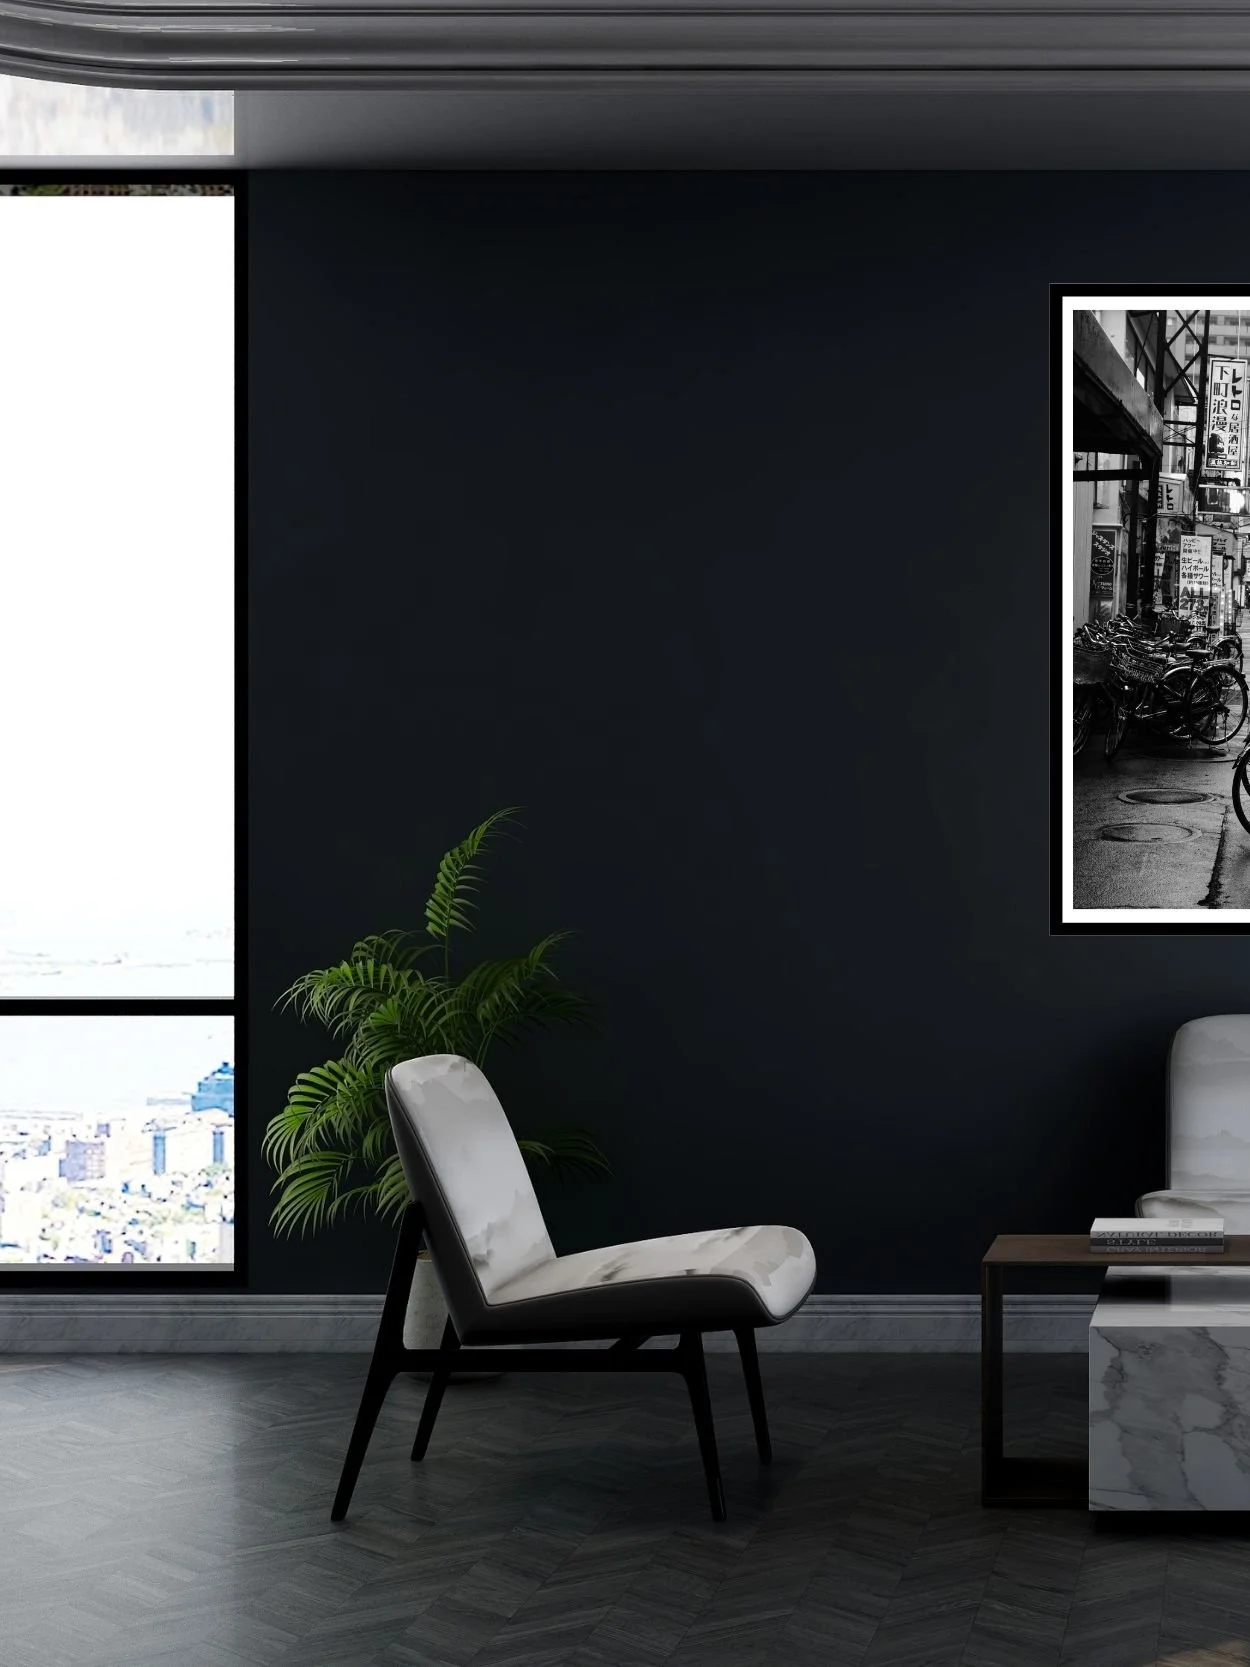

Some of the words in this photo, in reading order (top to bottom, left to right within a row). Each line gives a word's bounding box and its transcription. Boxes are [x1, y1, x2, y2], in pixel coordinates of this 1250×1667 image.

[1211, 365, 1230, 432] 下町浪漫
[1166, 484, 1174, 511] レトロ
[1181, 557, 1204, 565] 生ビール
[1181, 565, 1209, 573] ハイボール
[1180, 587, 1209, 599] ALL
